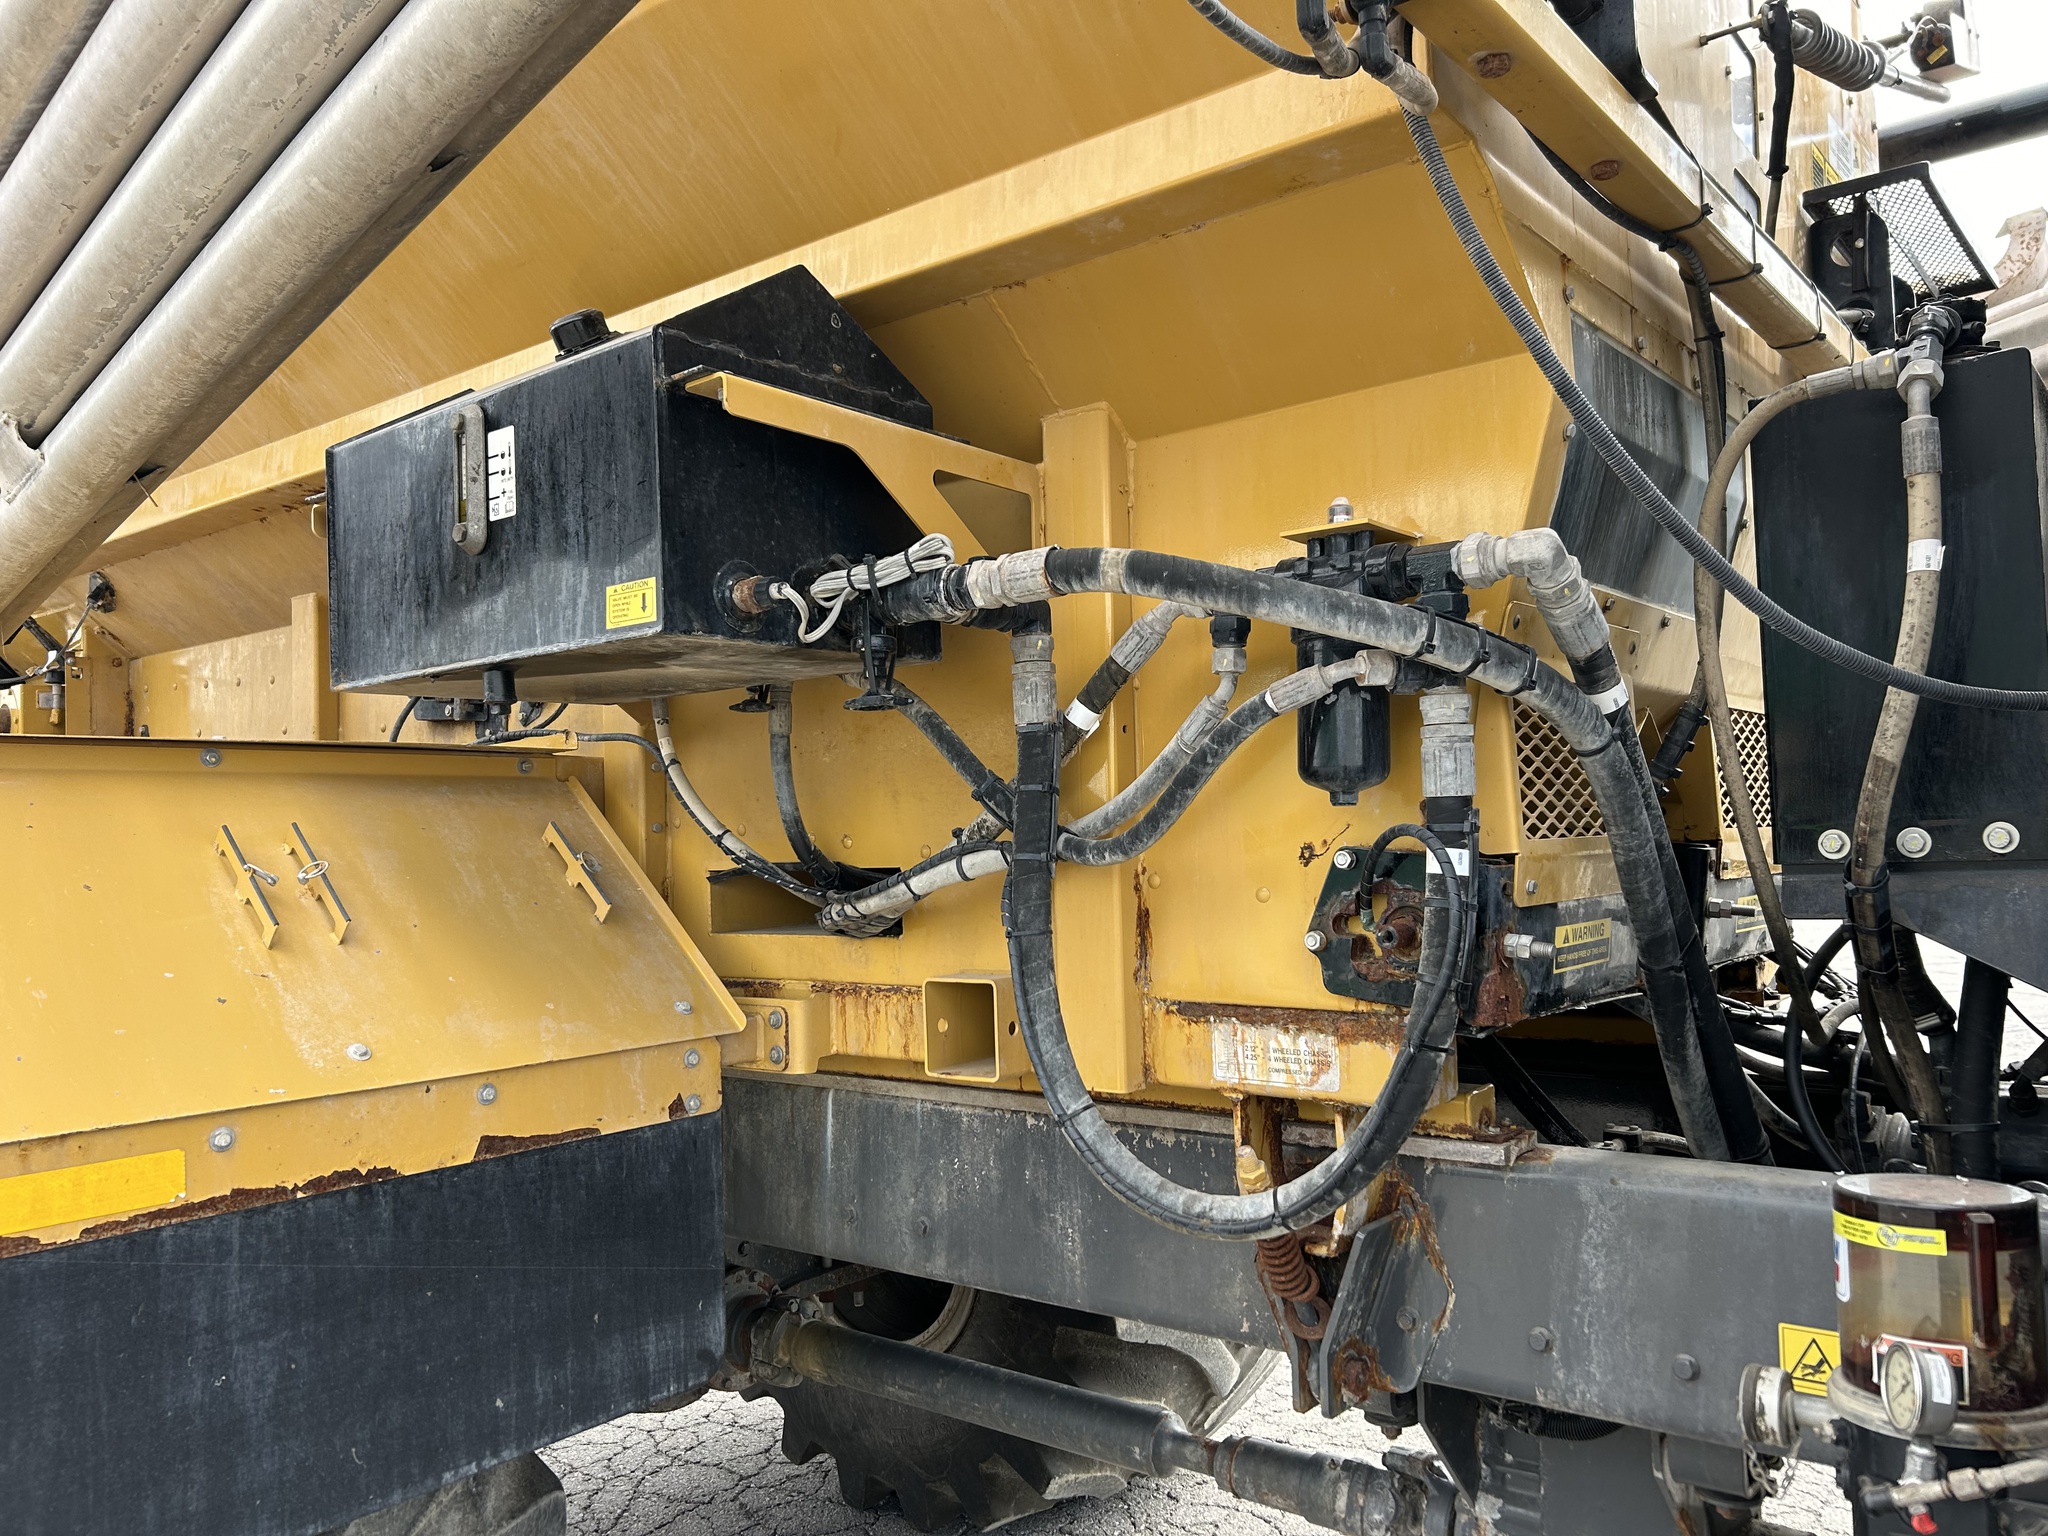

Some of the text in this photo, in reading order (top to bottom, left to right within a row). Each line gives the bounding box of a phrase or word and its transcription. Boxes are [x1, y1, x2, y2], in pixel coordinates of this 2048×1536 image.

[620, 580, 649, 592] CAUTION
[1572, 922, 1605, 942] WARNING
[1567, 952, 1578, 961] HANDS
[1578, 950, 1587, 958] FREE
[1272, 1047, 1302, 1056] WHEELED
[1274, 1056, 1302, 1065] WHEELED
[1304, 1058, 1332, 1068] CHASSIS
[1268, 1066, 1302, 1076] COMPRESSED
